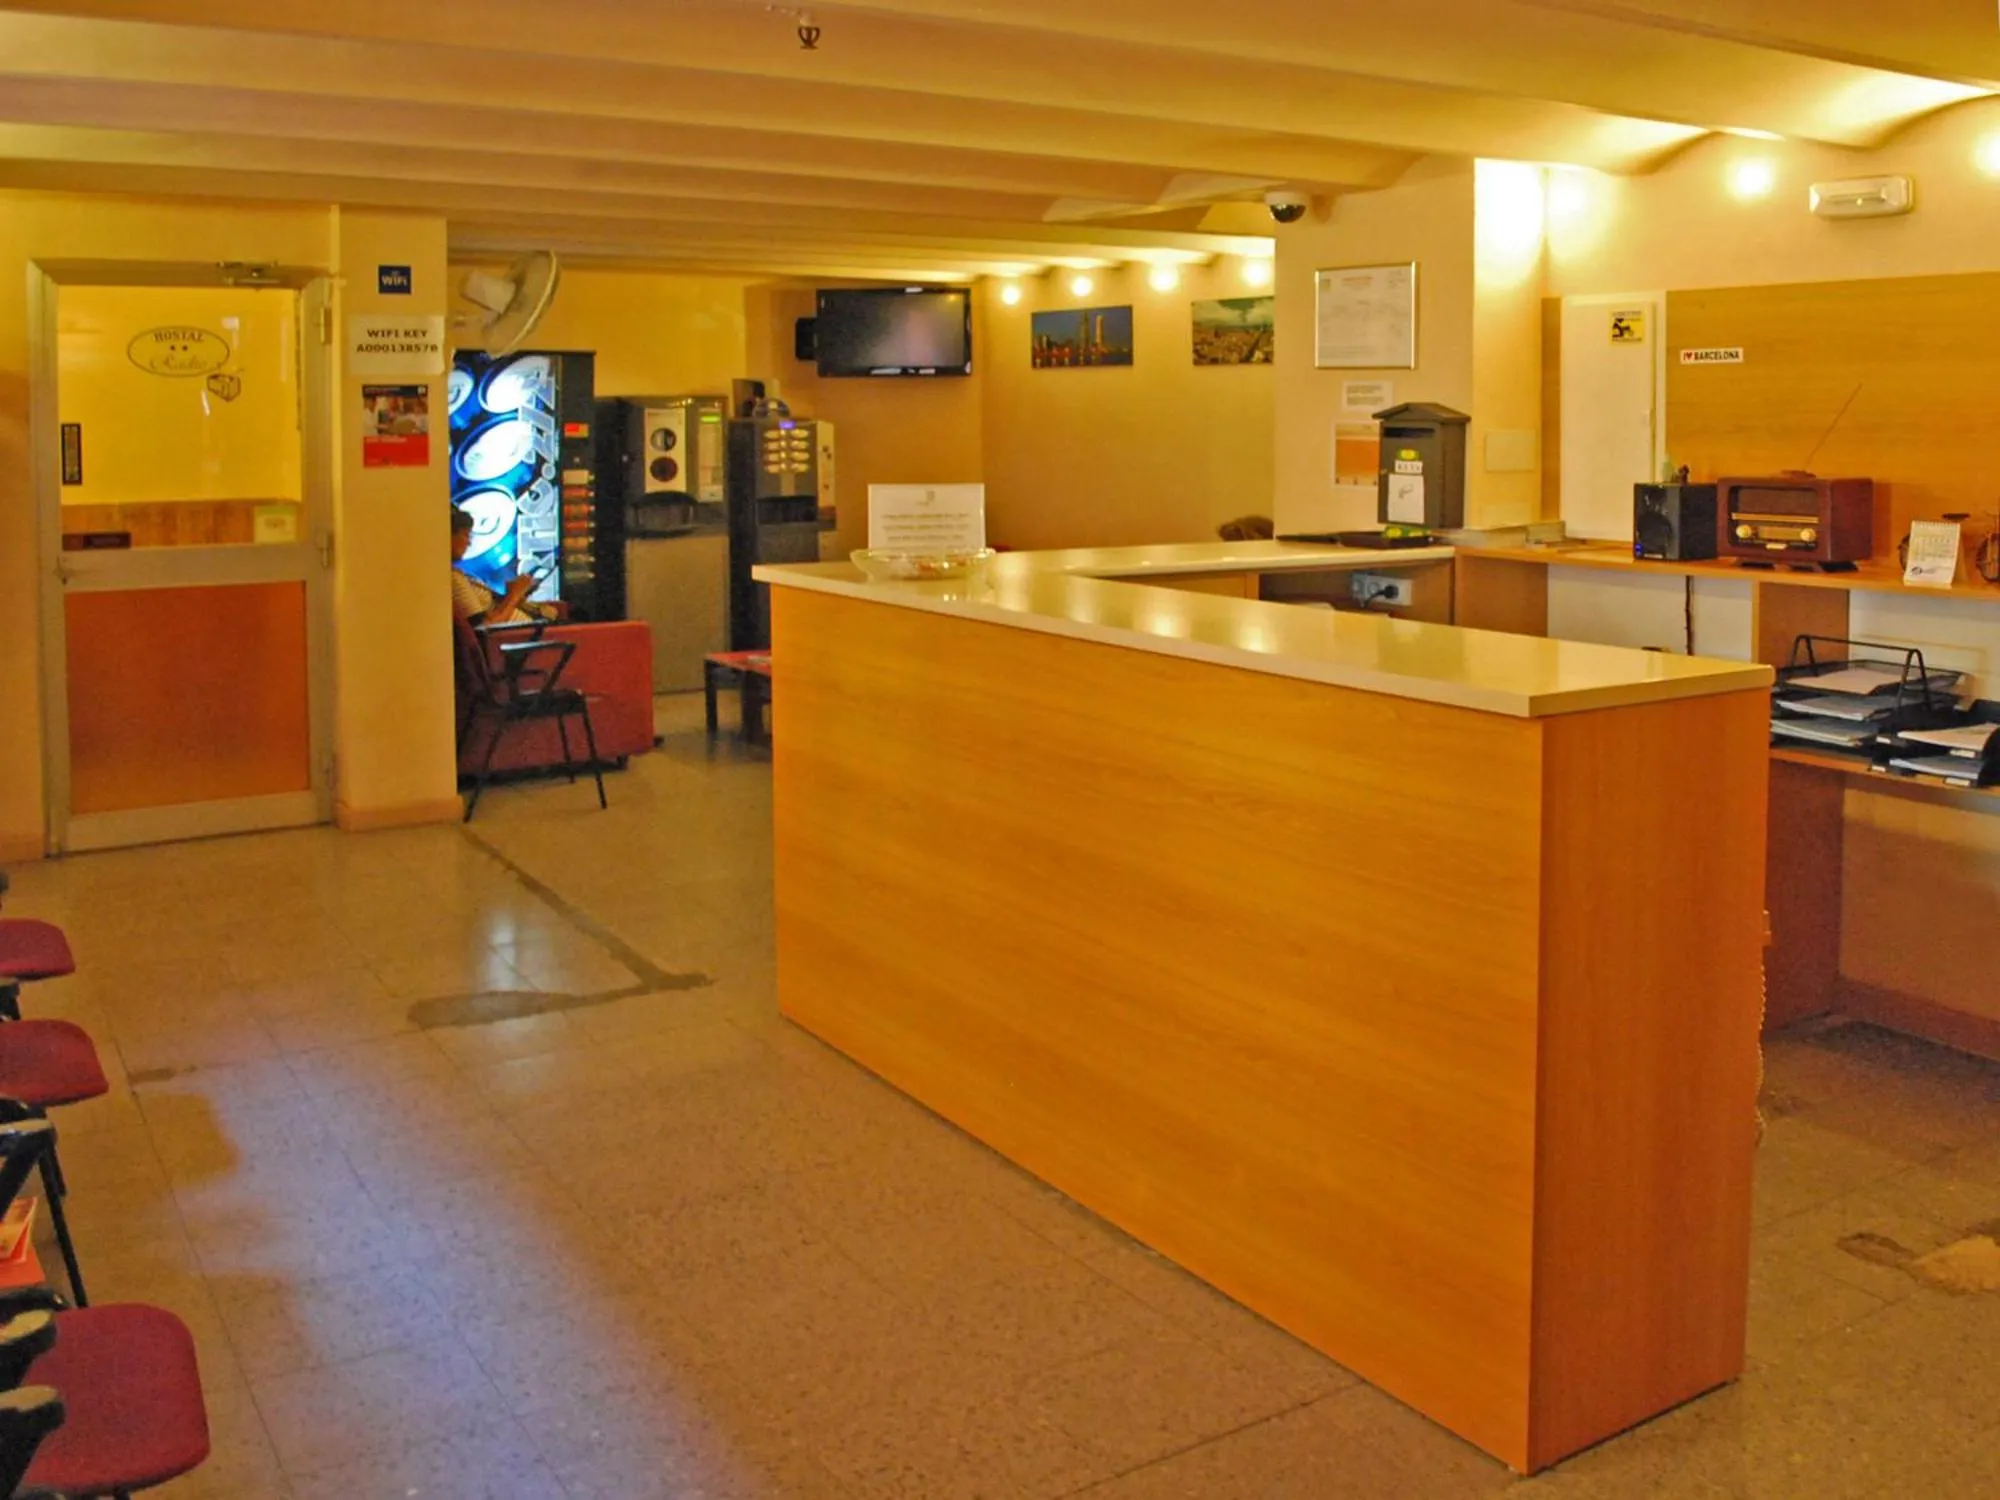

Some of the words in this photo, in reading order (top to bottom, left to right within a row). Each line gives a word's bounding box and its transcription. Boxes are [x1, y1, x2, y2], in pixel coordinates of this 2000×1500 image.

[154, 331, 204, 342] HOSTAL
[366, 329, 400, 338] WIFI
[403, 329, 428, 338] KEY
[1693, 350, 1740, 361] BARCELONA
